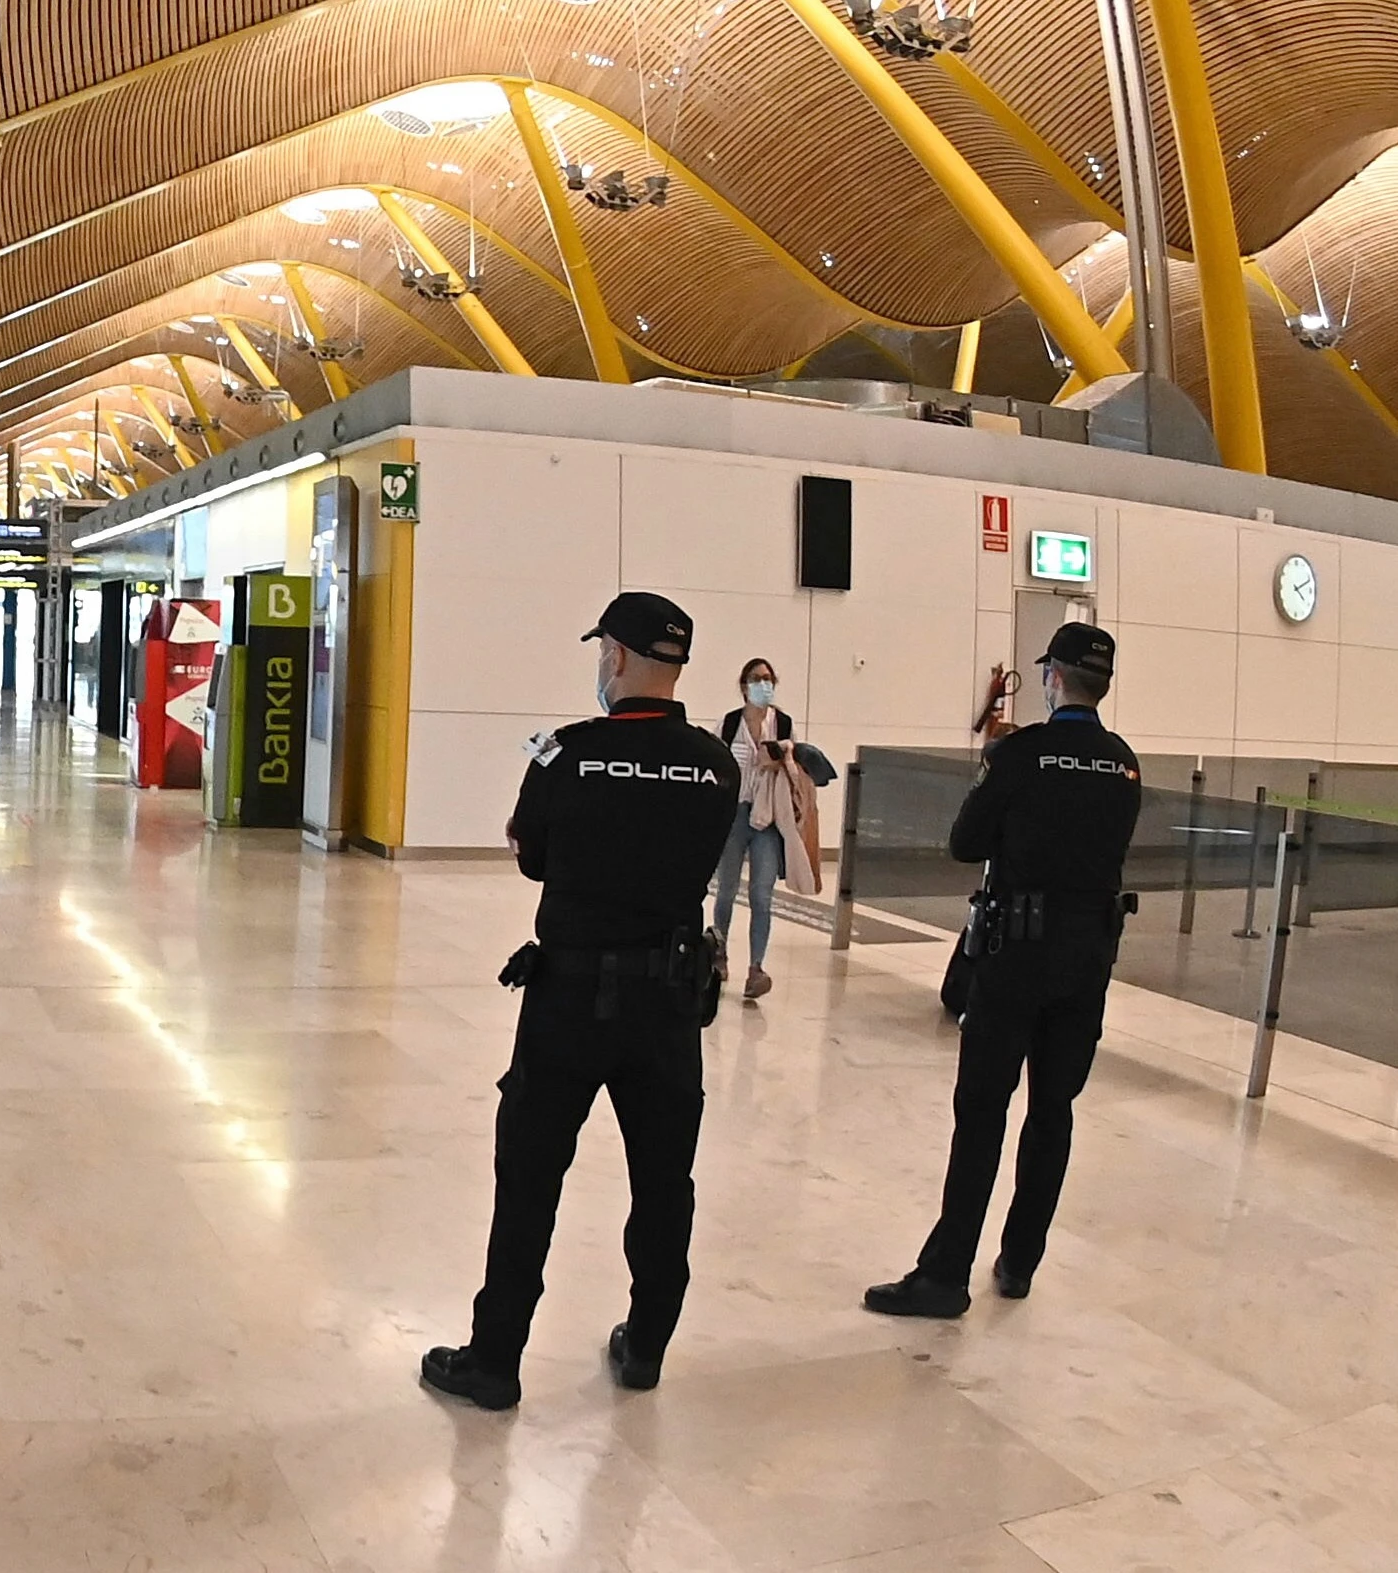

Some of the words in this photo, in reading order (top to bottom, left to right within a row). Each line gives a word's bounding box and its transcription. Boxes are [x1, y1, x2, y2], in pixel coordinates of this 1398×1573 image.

[391, 506, 416, 518] DEA
[268, 583, 296, 619] B
[258, 656, 293, 784] Bankia
[579, 760, 717, 785] POLICIA
[1039, 755, 1127, 775] POLICIA
